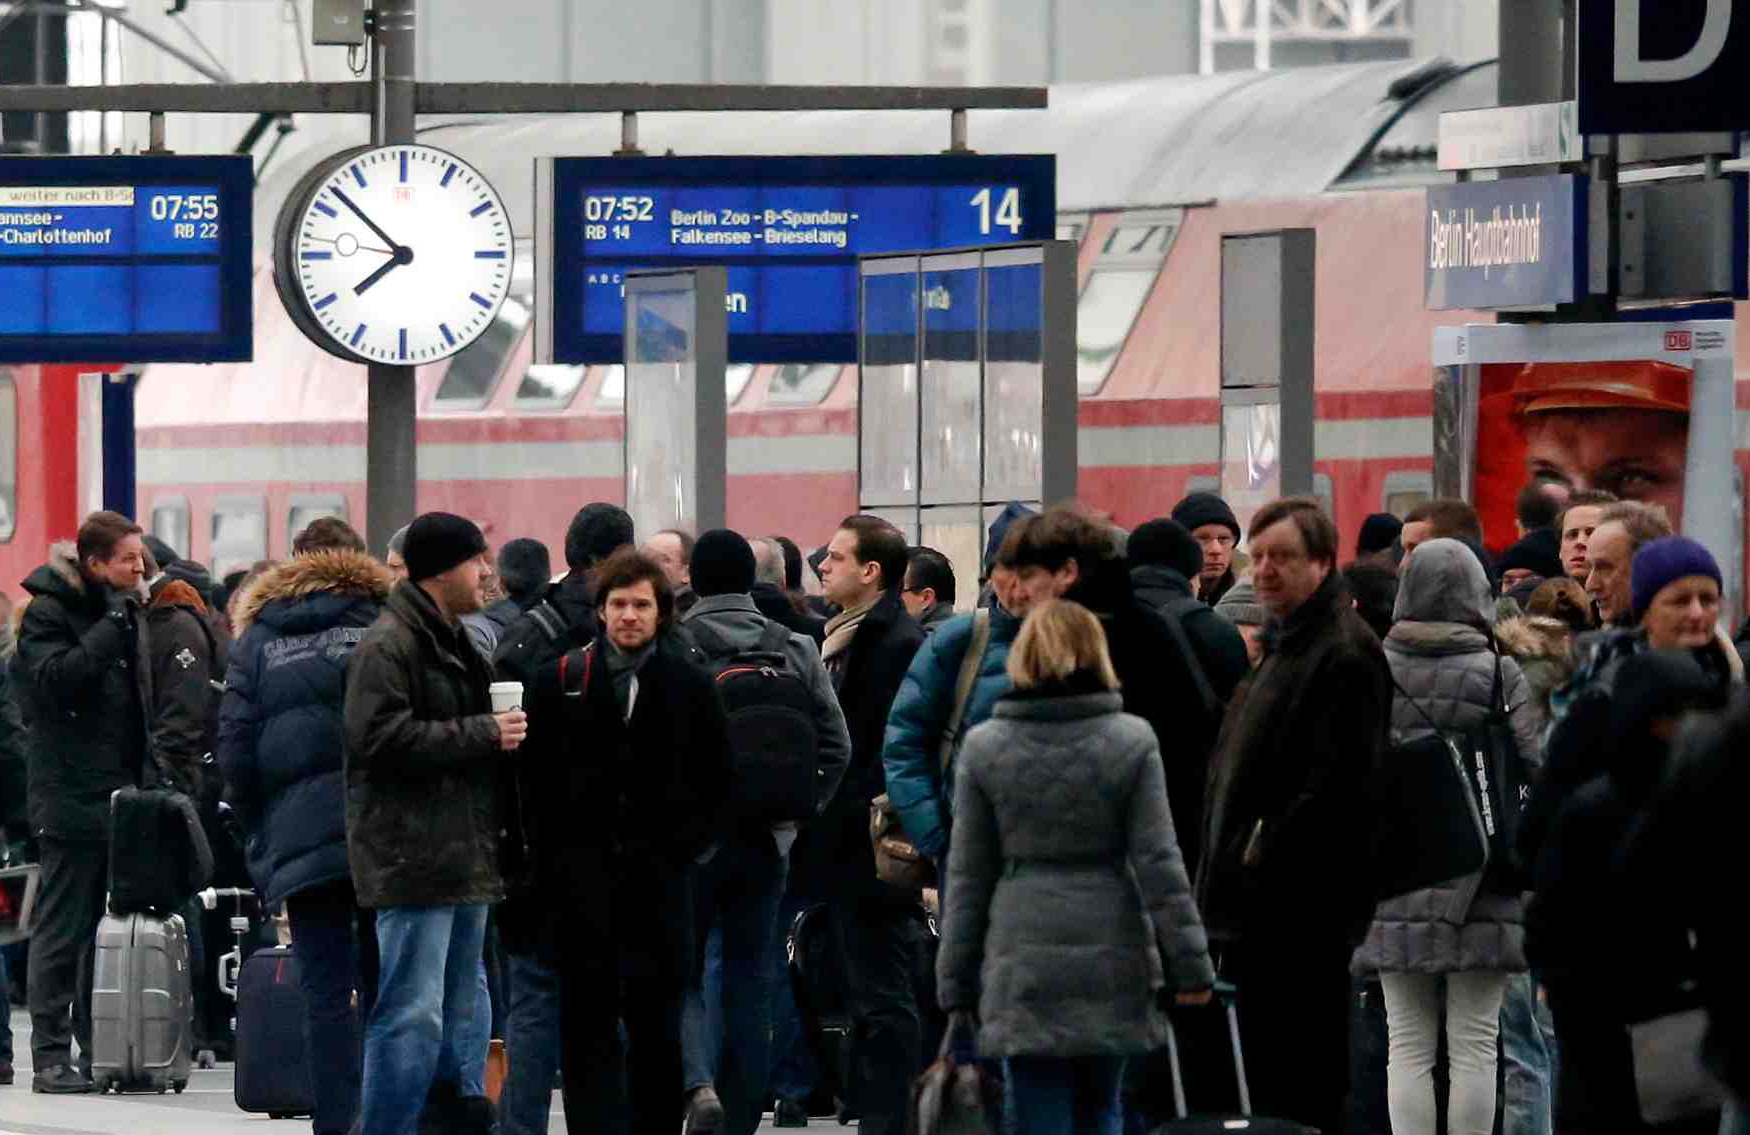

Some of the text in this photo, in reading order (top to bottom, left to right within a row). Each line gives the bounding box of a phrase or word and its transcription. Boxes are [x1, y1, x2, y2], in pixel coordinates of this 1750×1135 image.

[1614, 0, 1732, 83] D
[9, 189, 58, 202] weiter
[65, 188, 99, 202] nach
[151, 195, 219, 220] 07:55
[585, 187, 1023, 235] 07:52 14
[670, 209, 717, 226] Berlin
[721, 210, 750, 226] Zoo
[764, 209, 848, 228] B-Spandau
[175, 223, 219, 239] RB 22
[585, 224, 630, 240] RB 14
[670, 229, 751, 245] Falkensee
[764, 229, 848, 248] Brieselang
[1430, 201, 1541, 281] Berlin Hauptbahnhof
[1665, 329, 1691, 351] DB
